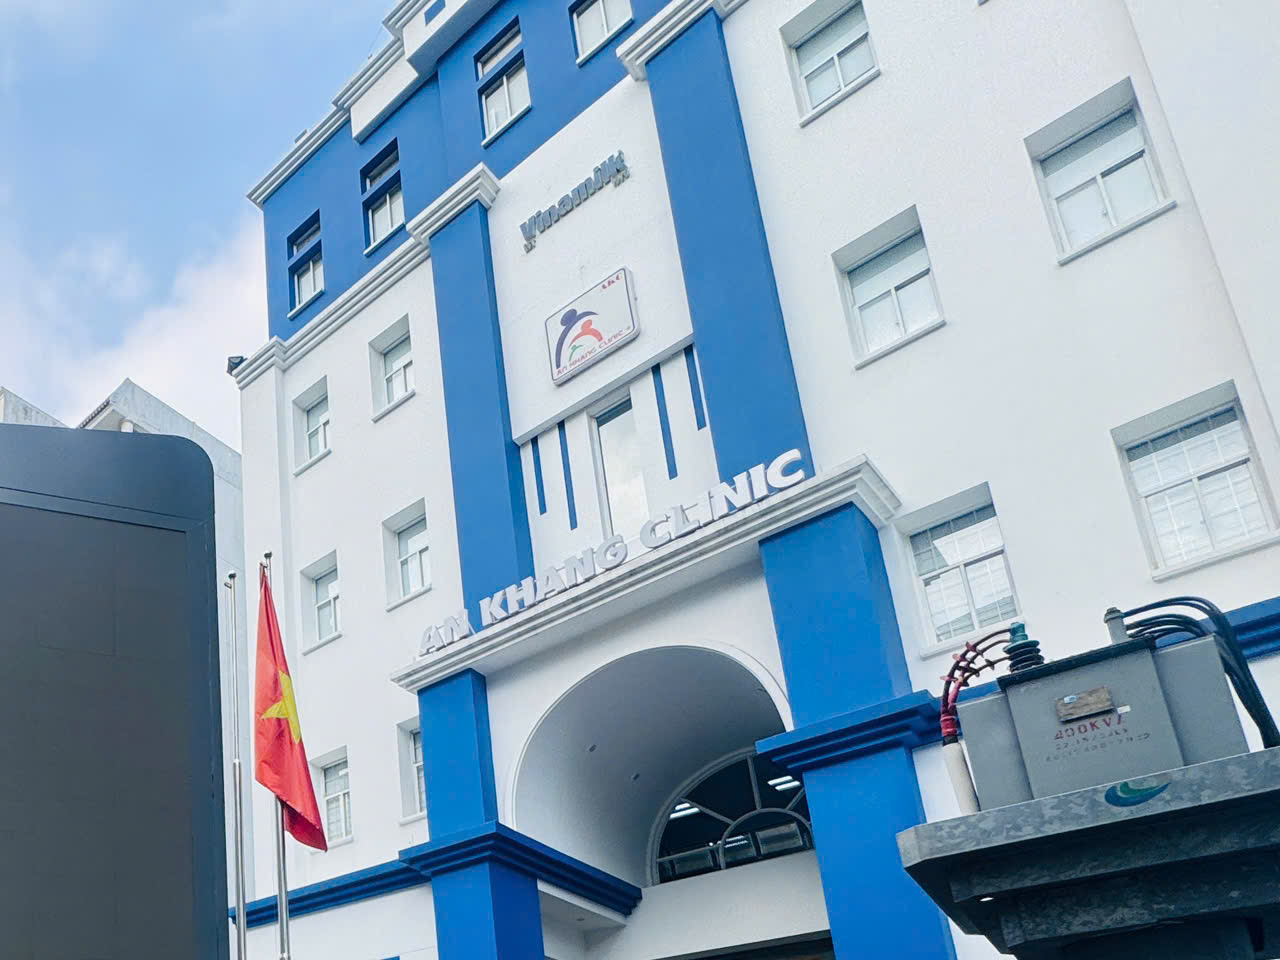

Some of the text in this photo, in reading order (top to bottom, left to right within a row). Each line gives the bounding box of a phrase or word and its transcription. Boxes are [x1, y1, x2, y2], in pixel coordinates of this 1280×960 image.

[520, 150, 628, 240] Vinamilk
[419, 448, 807, 655] AN KHANG CLINIC
